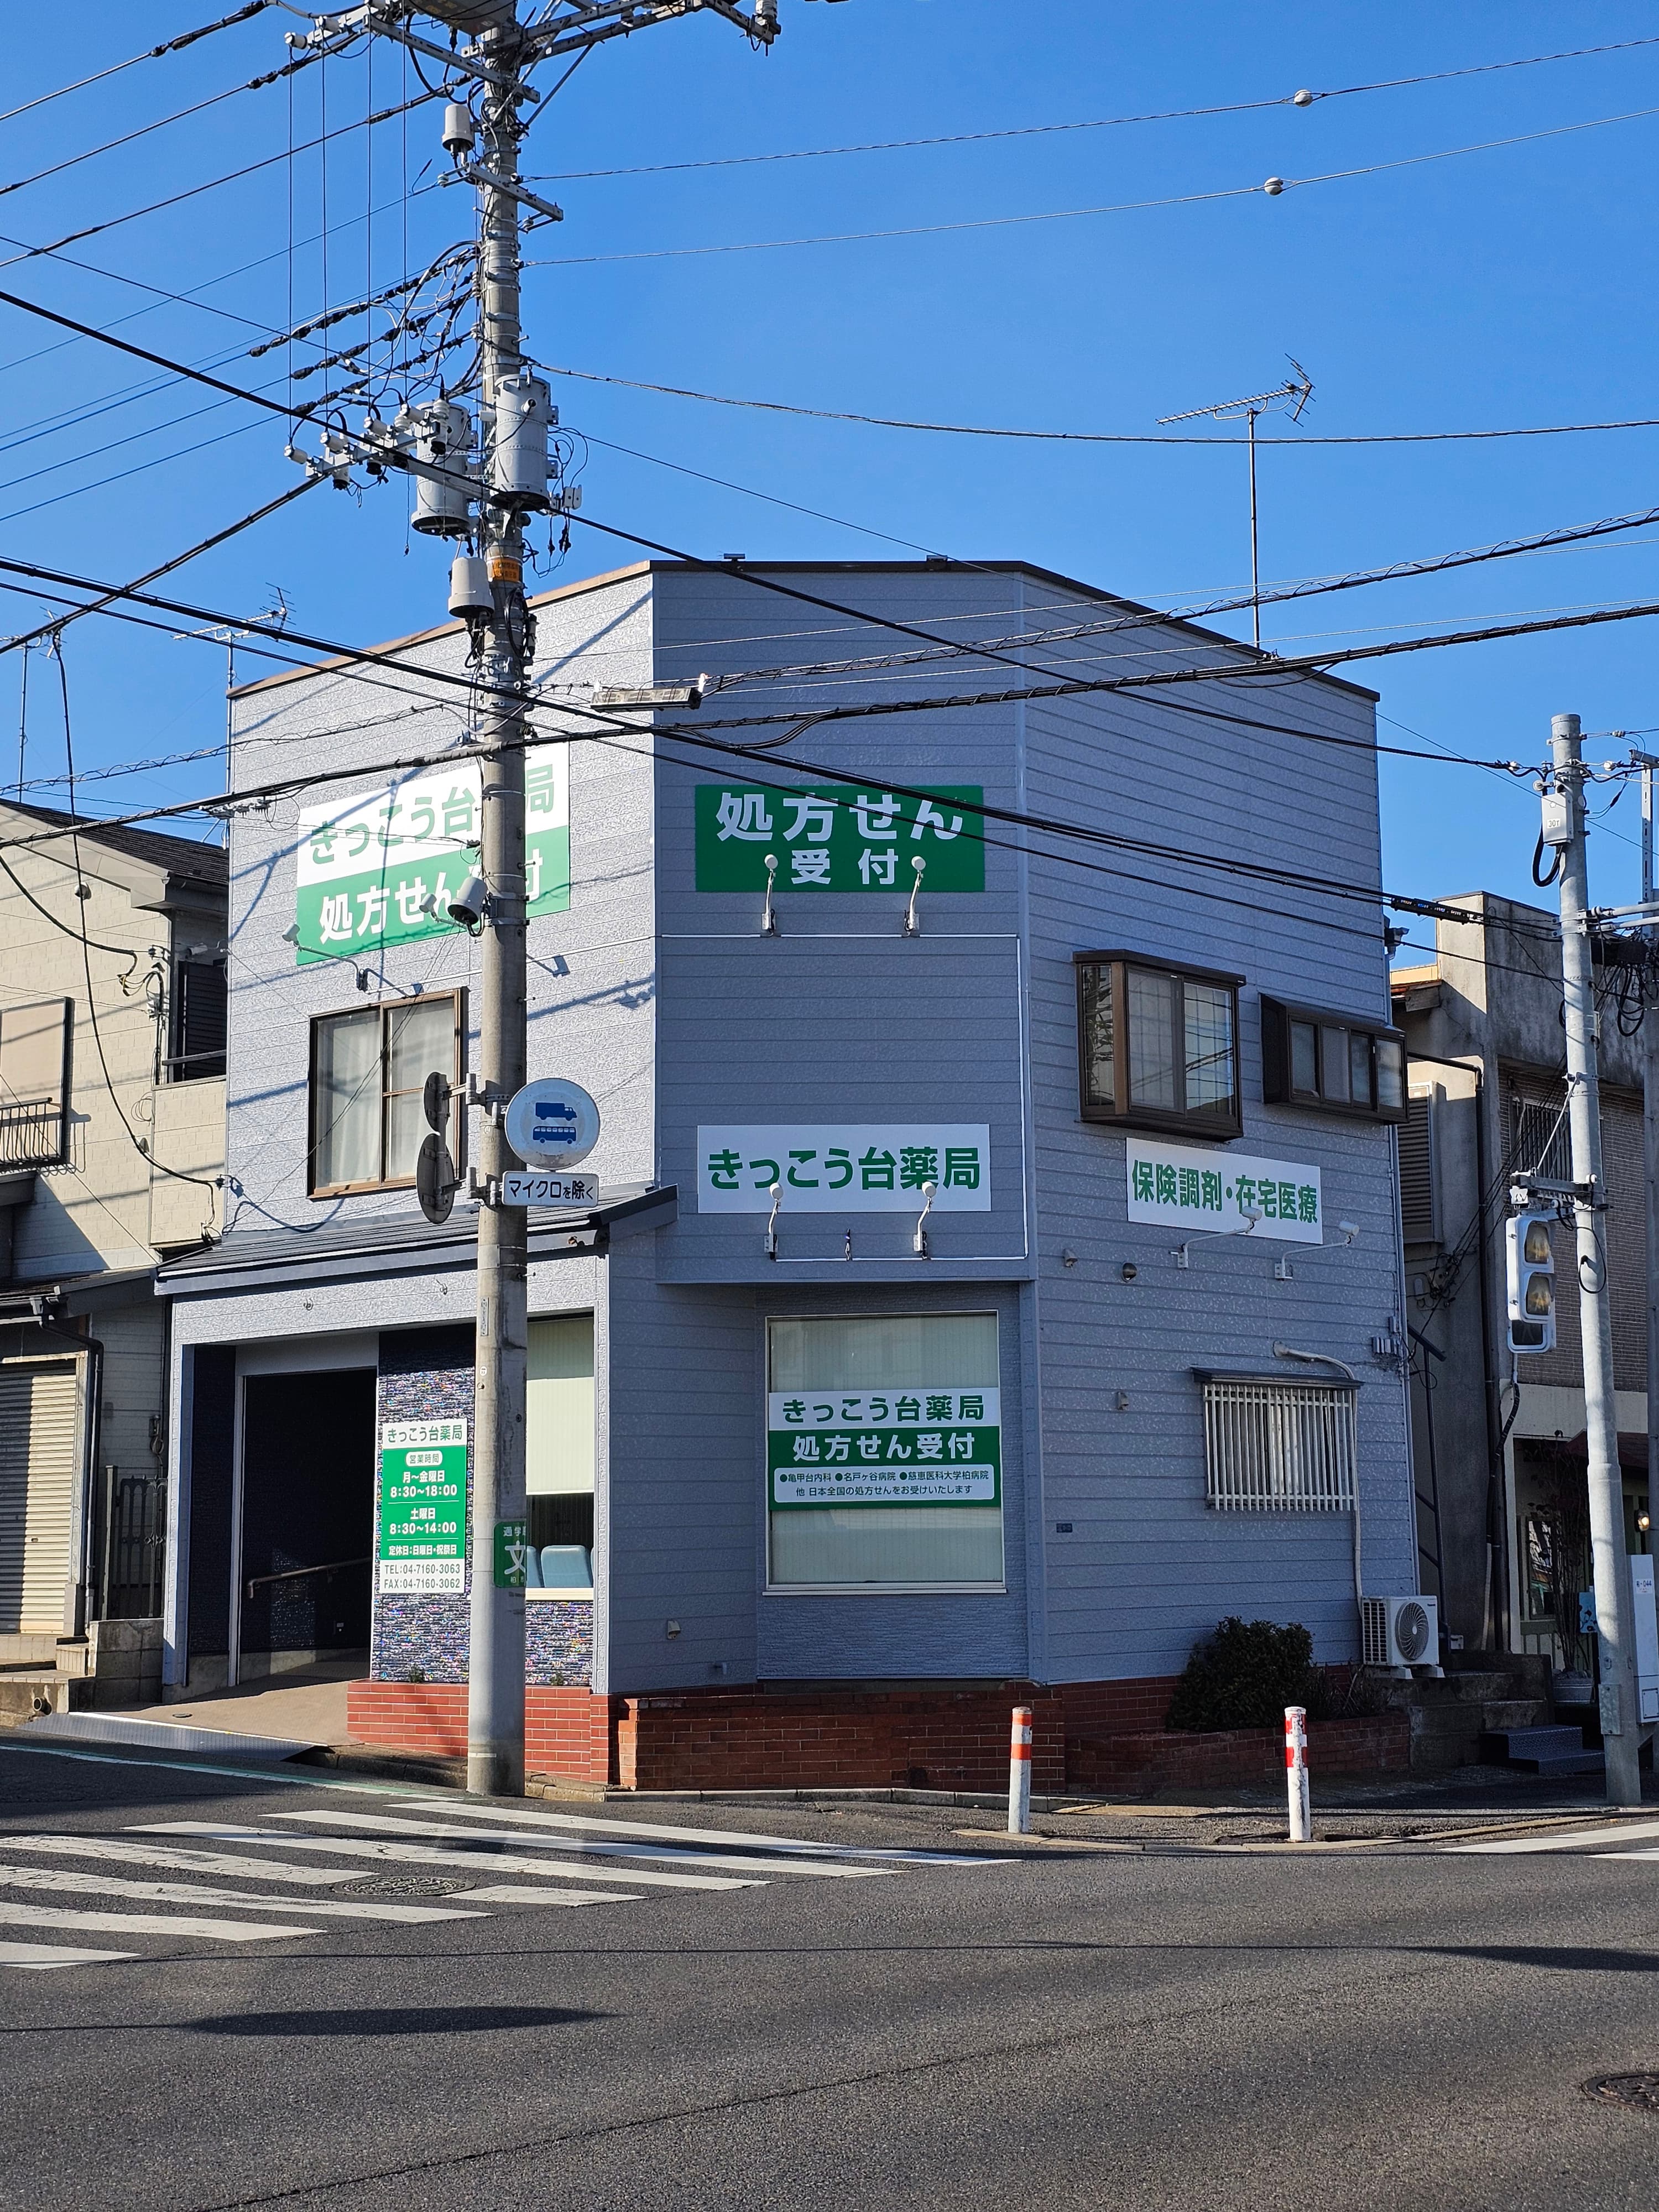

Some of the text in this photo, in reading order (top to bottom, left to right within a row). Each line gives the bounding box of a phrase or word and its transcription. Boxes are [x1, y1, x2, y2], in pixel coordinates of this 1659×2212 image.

[310, 764, 555, 864] きっこう台局
[716, 792, 963, 841] 処方せん
[791, 848, 899, 885] 受付
[319, 848, 544, 945] 処方せん
[707, 1146, 980, 1191] きっこう台薬局
[508, 1180, 593, 1200] マイクロを除く
[1131, 1159, 1318, 1224] 保険調剤・在宅医療
[782, 1394, 984, 1423] きっこう台薬局
[387, 1425, 462, 1443] きっこう台薬局
[792, 1432, 975, 1462] 処方せん受付
[409, 1453, 439, 1464] 営業時間
[796, 1485, 972, 1496] 他 日本全国の処方せんをお受けいたします
[410, 1507, 436, 1520] 土曜日
[384, 1563, 460, 1574] TEL:04-7160-3063
[384, 1578, 460, 1589] FAX:04-7160-3062
